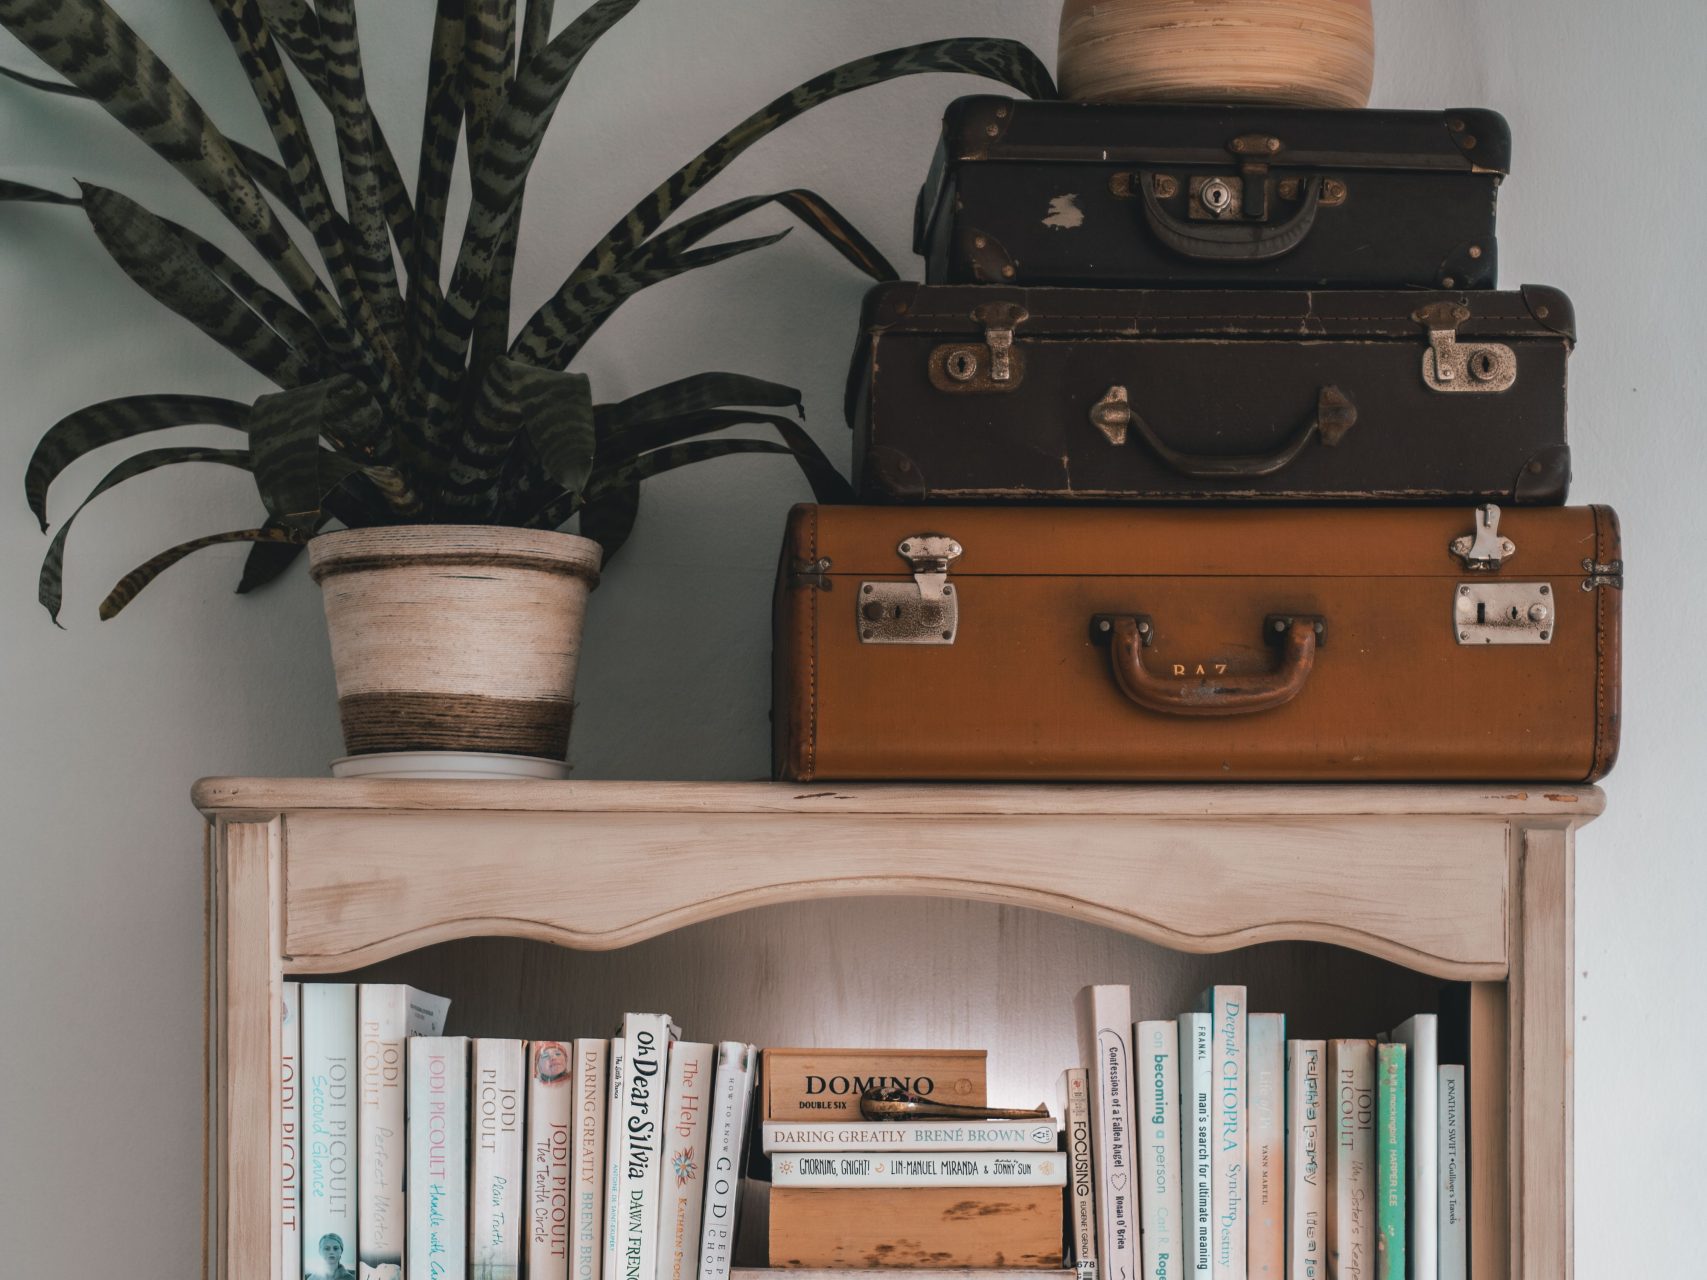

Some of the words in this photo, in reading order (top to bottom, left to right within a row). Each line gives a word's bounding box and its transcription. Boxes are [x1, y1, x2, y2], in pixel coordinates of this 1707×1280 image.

[1198, 1026, 1206, 1060] FRANKL
[1225, 1001, 1239, 1056] Deepak
[328, 1057, 347, 1108] JODI
[364, 1021, 379, 1109] PICOULT
[381, 1042, 399, 1087] JODI
[428, 1055, 445, 1096] JODI
[584, 1052, 597, 1112] DARING
[631, 1057, 658, 1115] Dear
[805, 1076, 934, 1096] DOMINO
[311, 1075, 327, 1135] Second
[481, 1070, 496, 1154] PICOULT
[501, 1089, 516, 1132] JODI
[1198, 1093, 1207, 1118] man's
[1223, 1060, 1238, 1151] CHOPRA
[1341, 1070, 1354, 1151] PICOULT
[1355, 1088, 1372, 1131] JODI
[429, 1101, 445, 1179] PICOULT
[550, 1124, 567, 1167] JODI
[582, 1116, 596, 1185] GREATLY
[628, 1115, 654, 1181] Silvia
[774, 1130, 834, 1143] DARING
[838, 1130, 906, 1144] GREATLY
[915, 1127, 963, 1142] BRENÉ
[968, 1129, 1025, 1142] BROWN
[1074, 1121, 1089, 1197] FOCUSING
[1198, 1123, 1207, 1159] search
[310, 1139, 325, 1198] Glance
[329, 1123, 347, 1217] PICOULT
[1198, 1163, 1208, 1176] for
[1227, 1164, 1242, 1219] Synchro
[431, 1183, 446, 1227] Handle
[551, 1176, 566, 1259] PICOULT
[580, 1192, 593, 1240] BRENÉ
[630, 1190, 643, 1229] DAWN
[1198, 1179, 1209, 1222] ultimate
[431, 1231, 445, 1258] with
[1196, 1225, 1208, 1270] meaning
[1218, 1215, 1231, 1268] Destiny
